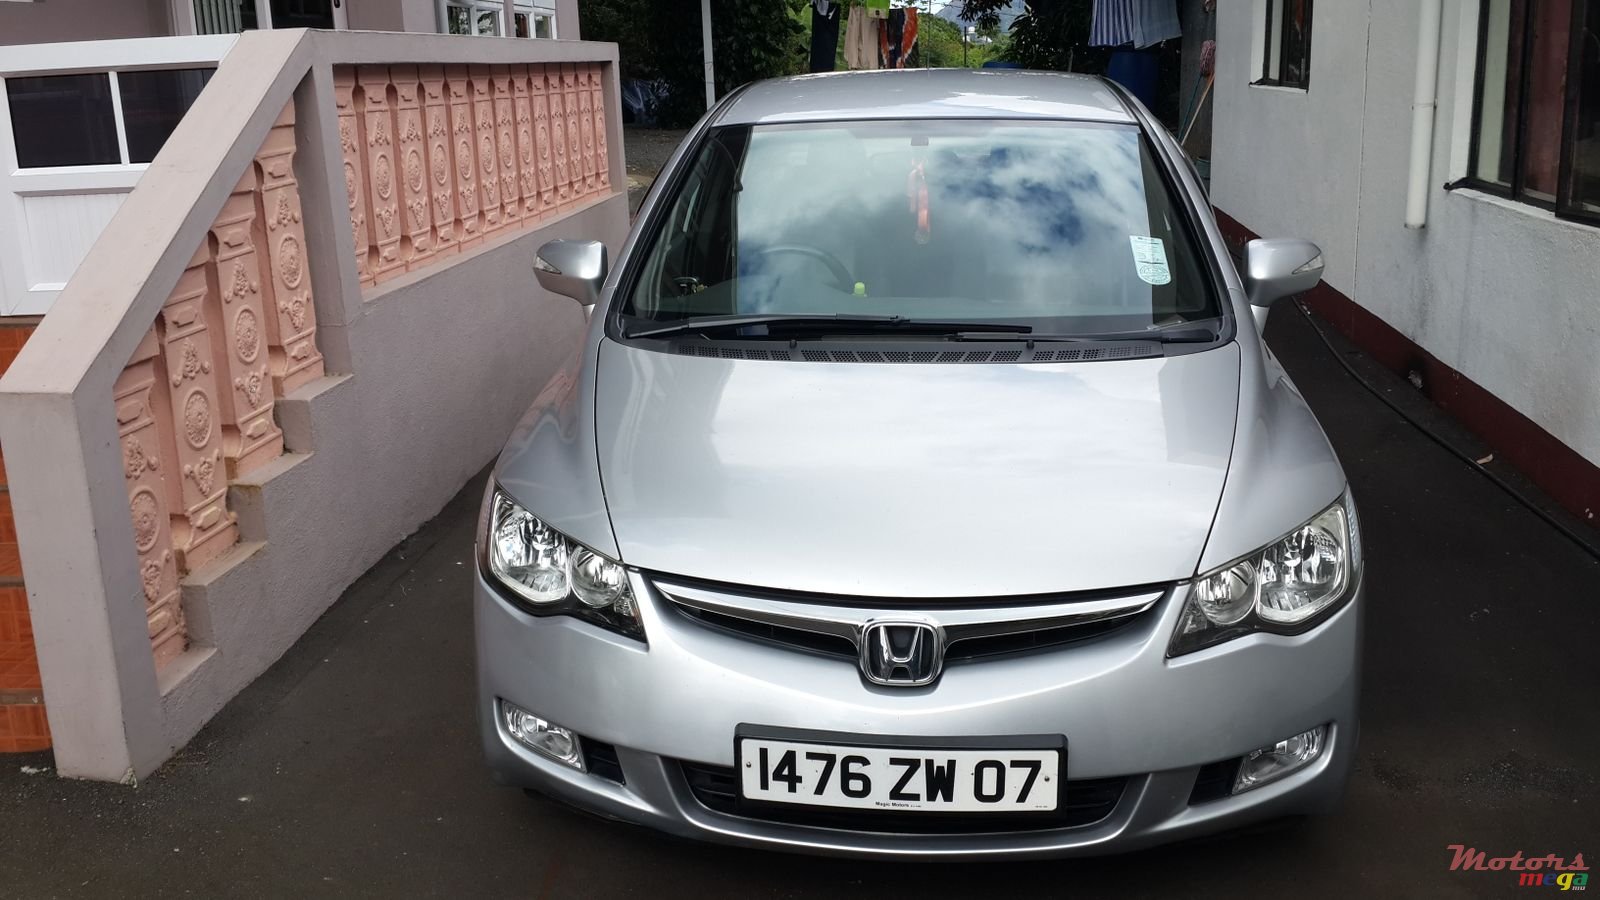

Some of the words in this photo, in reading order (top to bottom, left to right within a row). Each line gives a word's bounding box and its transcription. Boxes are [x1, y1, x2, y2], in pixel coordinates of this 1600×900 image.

[759, 747, 872, 799] 1476
[889, 757, 956, 802] ZW
[973, 759, 1042, 803] 07
